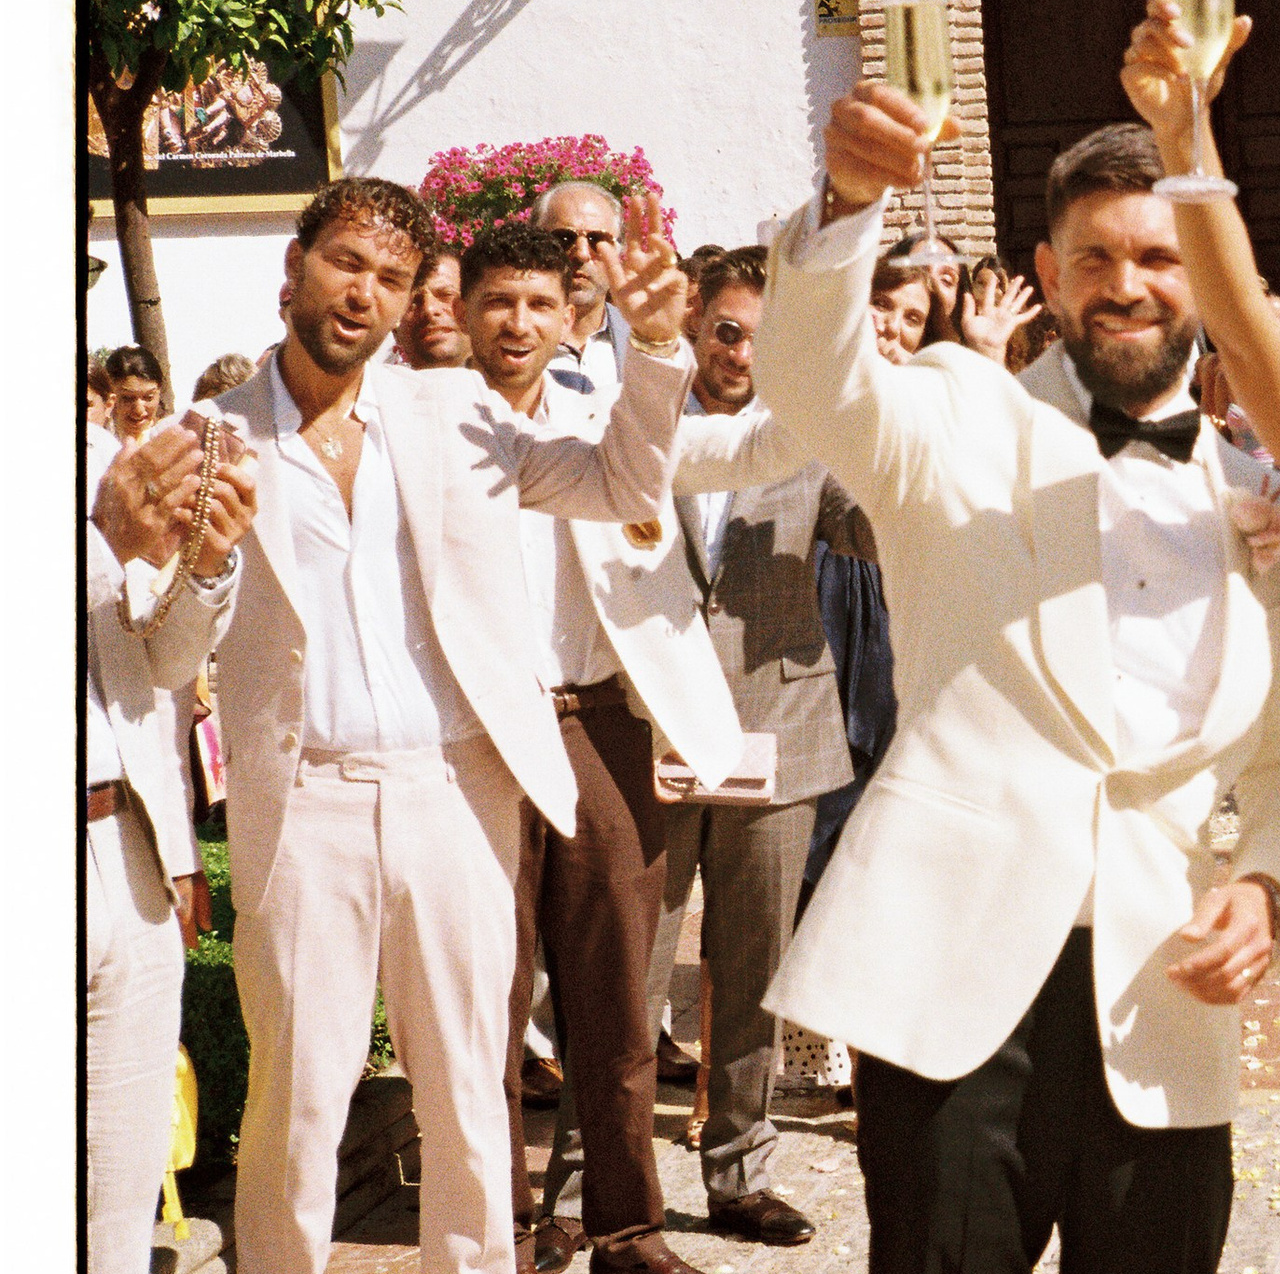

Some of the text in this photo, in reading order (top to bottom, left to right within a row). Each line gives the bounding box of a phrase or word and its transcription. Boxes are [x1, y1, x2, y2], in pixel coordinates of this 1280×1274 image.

[154, 152, 165, 160] del
[167, 152, 194, 160] Carmen
[195, 151, 227, 159] Coronada
[256, 150, 265, 158] de
[266, 149, 296, 157] Marbella
